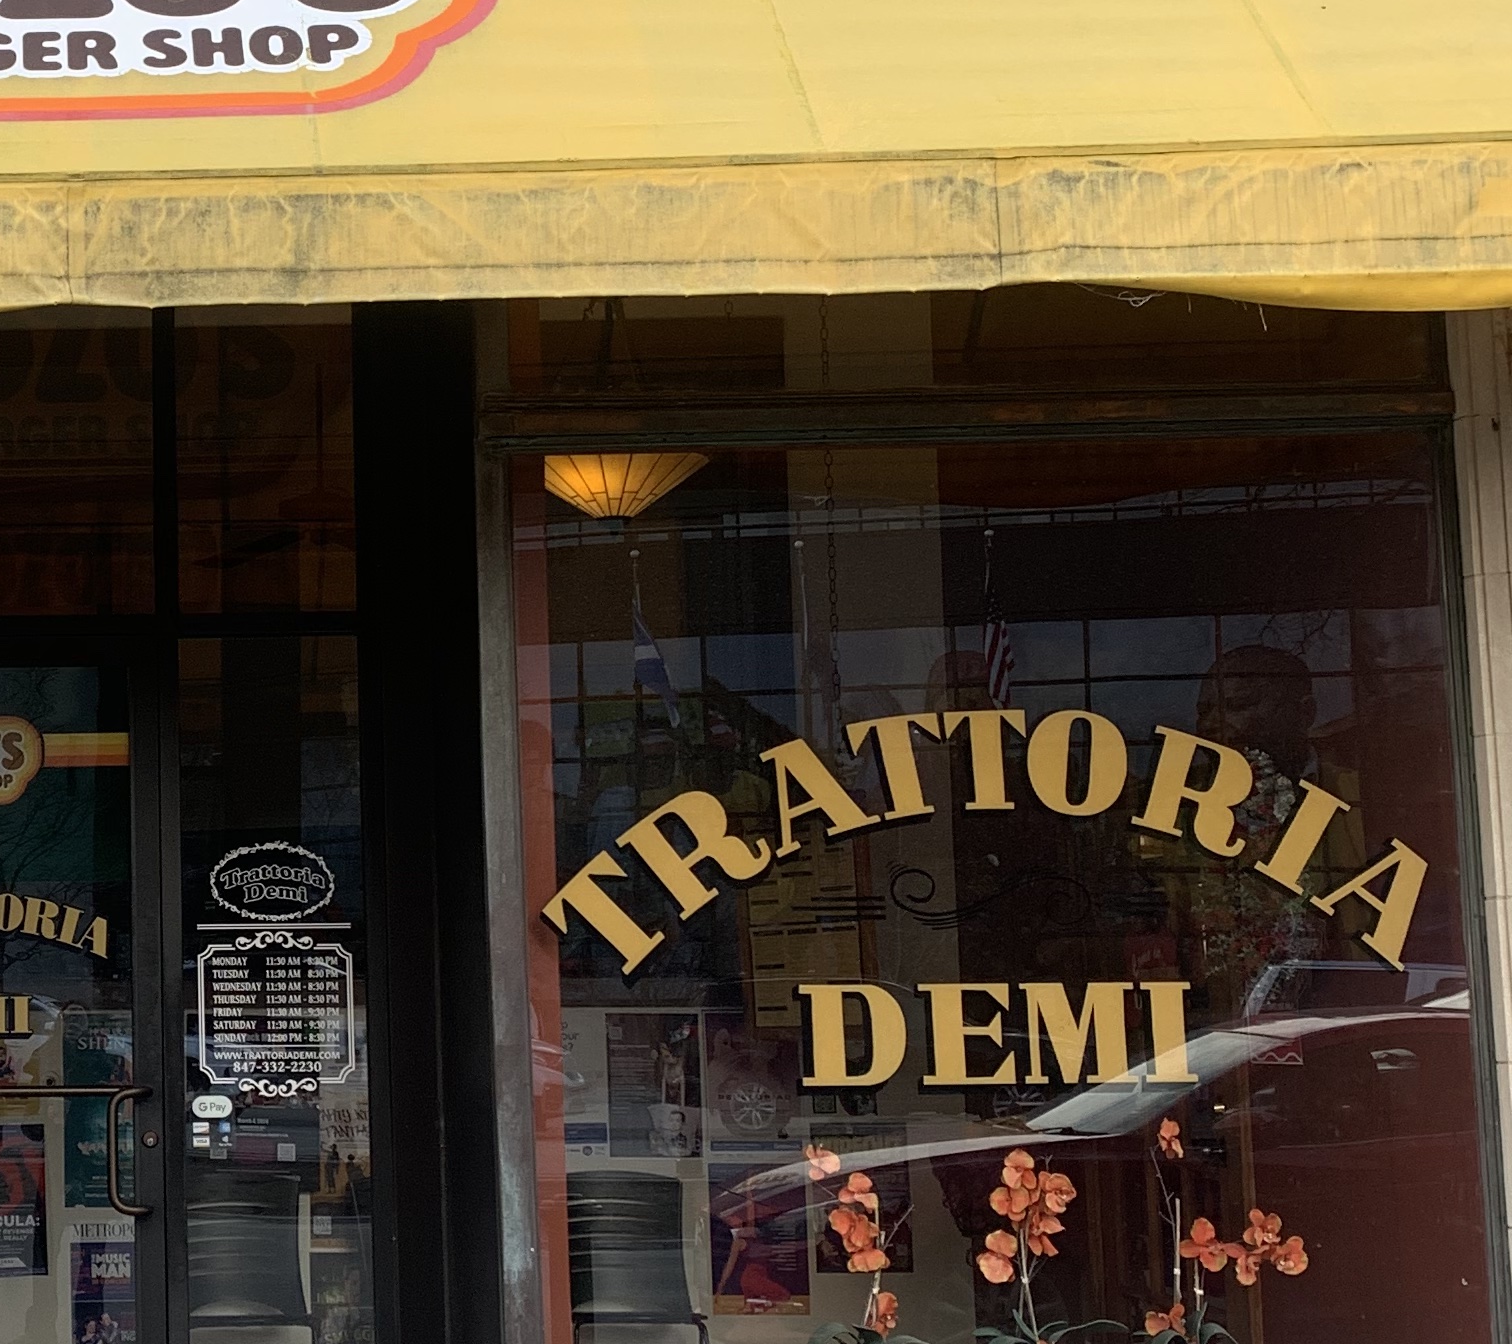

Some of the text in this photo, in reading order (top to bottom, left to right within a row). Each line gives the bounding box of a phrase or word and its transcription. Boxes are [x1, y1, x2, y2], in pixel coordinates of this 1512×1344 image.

[142, 26, 362, 70] SHOP
[541, 707, 1432, 976] TRATTORIA
[220, 864, 326, 889] Trattoria
[243, 883, 308, 903] Demi
[212, 956, 248, 966] MONDAY
[266, 956, 286, 966] 11:30
[288, 956, 301, 966] AM
[308, 956, 324, 966] 8:30
[326, 956, 339, 966] PM
[212, 969, 339, 979] TUESDAY 11:30 AM 8:30 PM
[212, 982, 262, 991] WEDNESDAY
[266, 982, 286, 991] 11:30
[288, 982, 301, 991] AM
[308, 982, 324, 991] 8:30
[326, 982, 339, 991] PM
[213, 995, 256, 1004] THURSDAY
[266, 995, 286, 1004] 11:30
[288, 995, 301, 1004] AM
[308, 995, 324, 1004] 8:30
[326, 995, 339, 1004] PM
[213, 1007, 243, 1017] FRIDAY
[267, 1007, 287, 1017] 11:30
[289, 1007, 302, 1017] AM
[309, 1007, 325, 1017] 9:30
[327, 1007, 340, 1017] PM
[213, 1020, 257, 1030] SATURDAY
[267, 1020, 287, 1030] 11:30
[289, 1020, 302, 1030] AM
[309, 1020, 325, 1030] 9:30
[327, 1020, 340, 1030] PM
[213, 1033, 247, 1043] SUNDAY
[267, 1033, 287, 1043] 12:00
[289, 1033, 302, 1043] PM
[309, 1033, 325, 1043] 8:30
[327, 1033, 340, 1043] PM
[797, 980, 1199, 1088] DEMI
[214, 1051, 341, 1060] WWW.TRATTORIADEMI.COM
[233, 1061, 322, 1073] 847-332-2230
[210, 1102, 227, 1113] Pay
[96, 1253, 131, 1263] MUSIC
[91, 1263, 131, 1279] MAN
